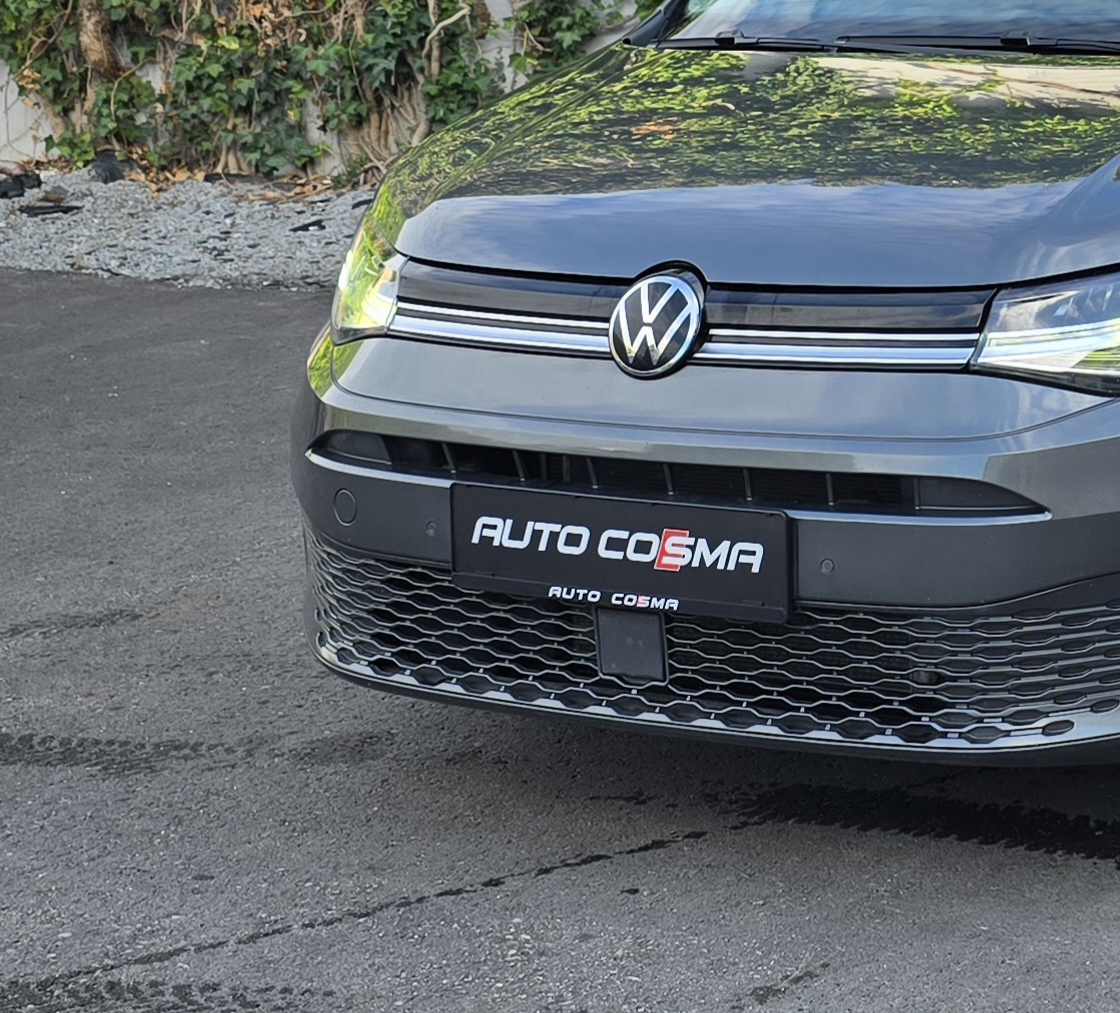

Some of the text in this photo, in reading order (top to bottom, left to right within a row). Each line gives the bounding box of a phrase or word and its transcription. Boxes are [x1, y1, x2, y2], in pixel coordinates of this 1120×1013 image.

[471, 516, 764, 573] AUTO COSMA
[548, 586, 679, 611] AUTO COSMA
